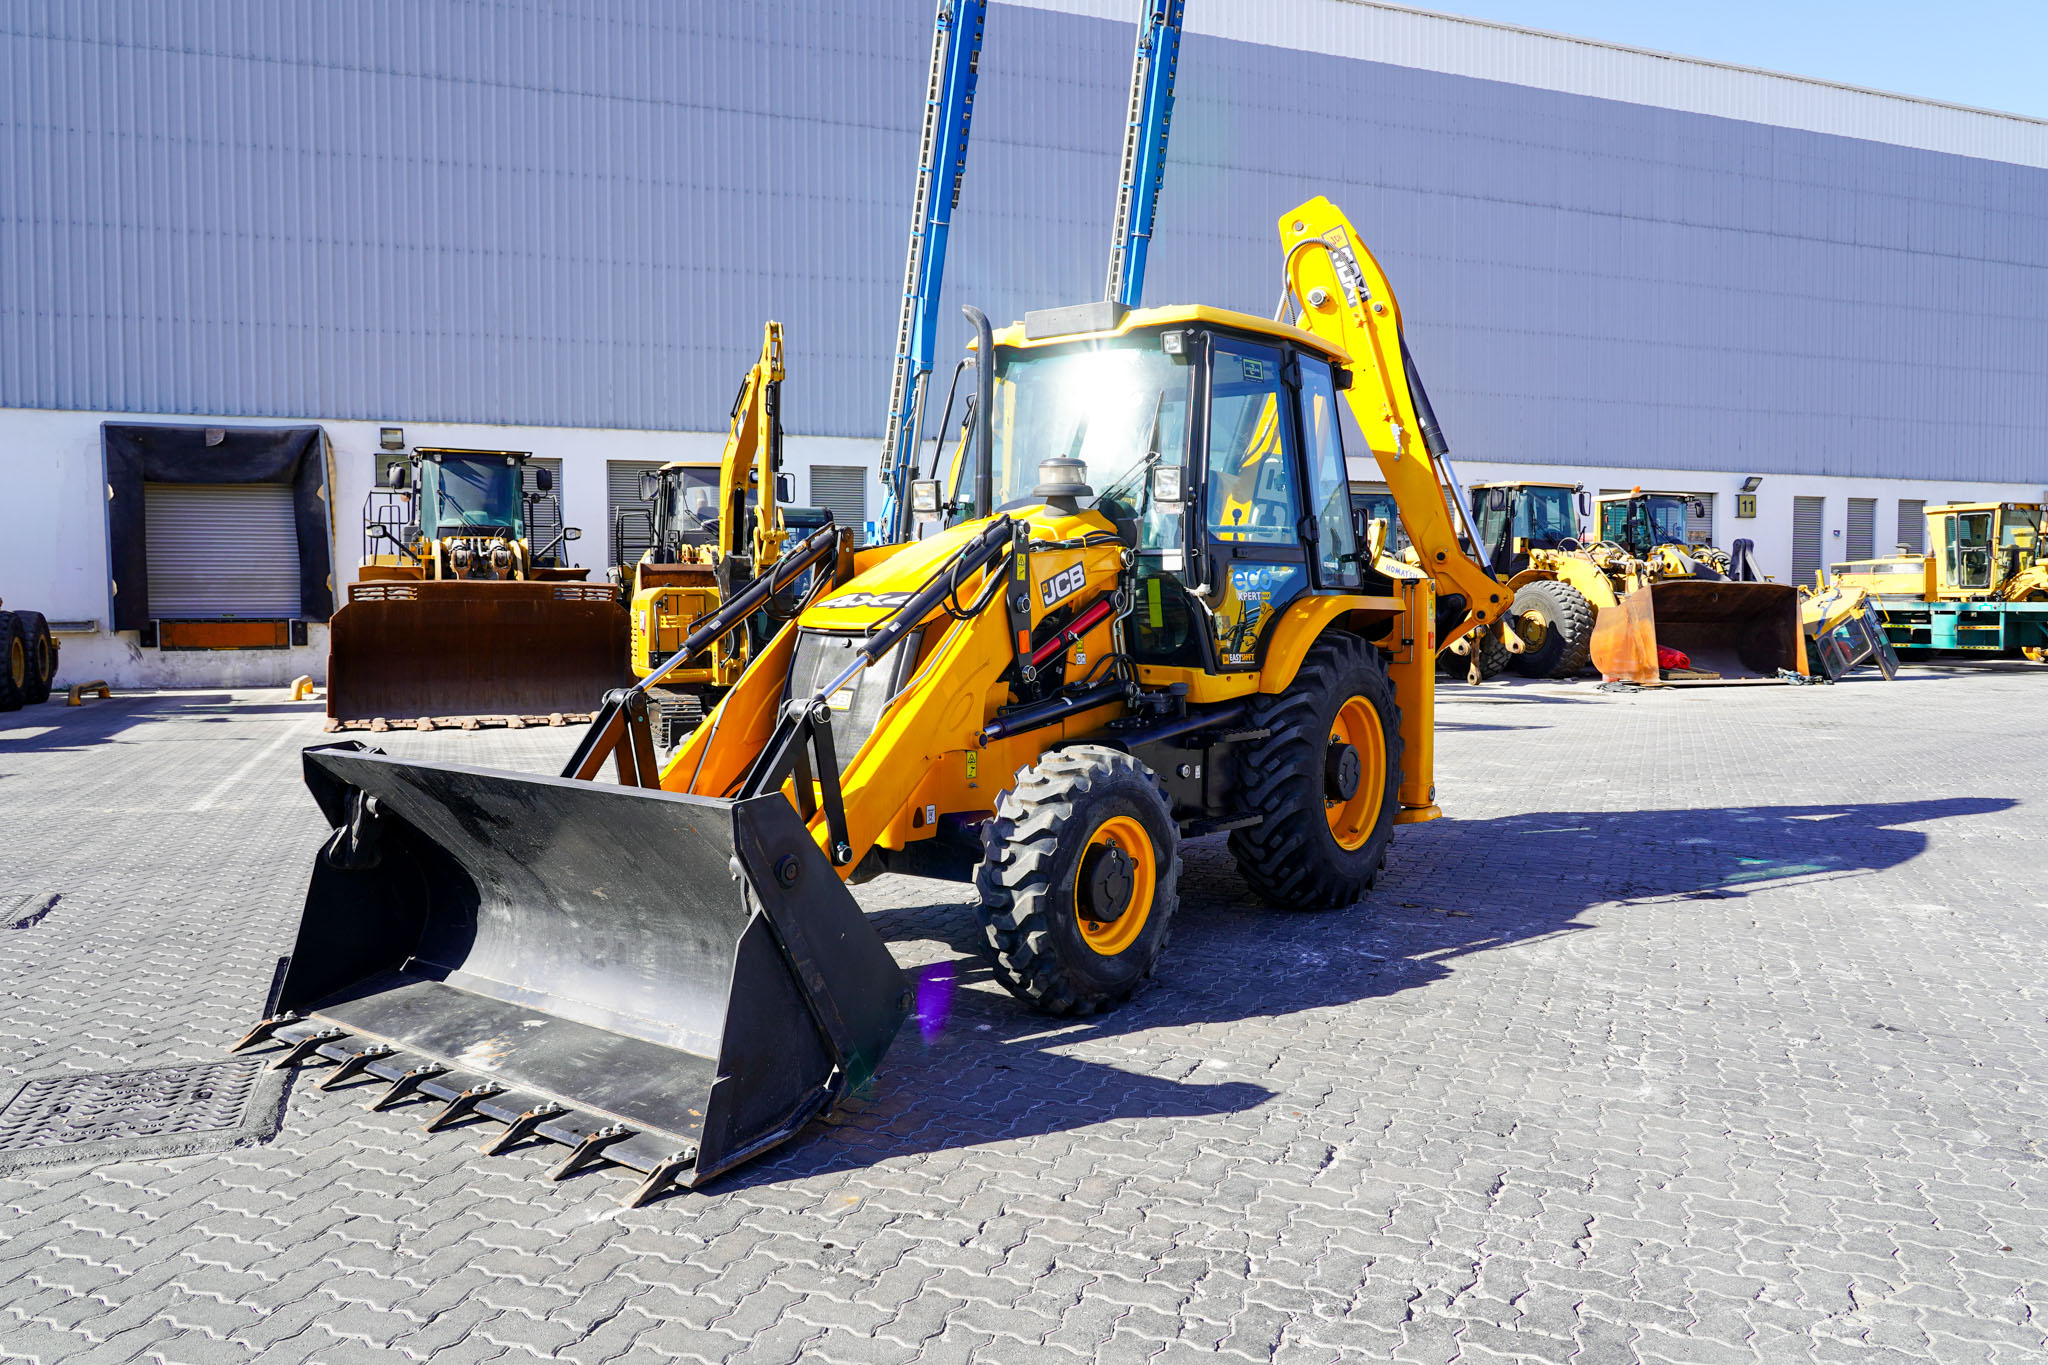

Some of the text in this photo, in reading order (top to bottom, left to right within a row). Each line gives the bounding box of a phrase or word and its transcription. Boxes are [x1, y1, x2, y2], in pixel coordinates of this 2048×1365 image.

[1742, 500, 1753, 512] 11
[1044, 564, 1085, 605] JCB
[1232, 569, 1272, 590] eco
[1238, 591, 1261, 601] XPERT
